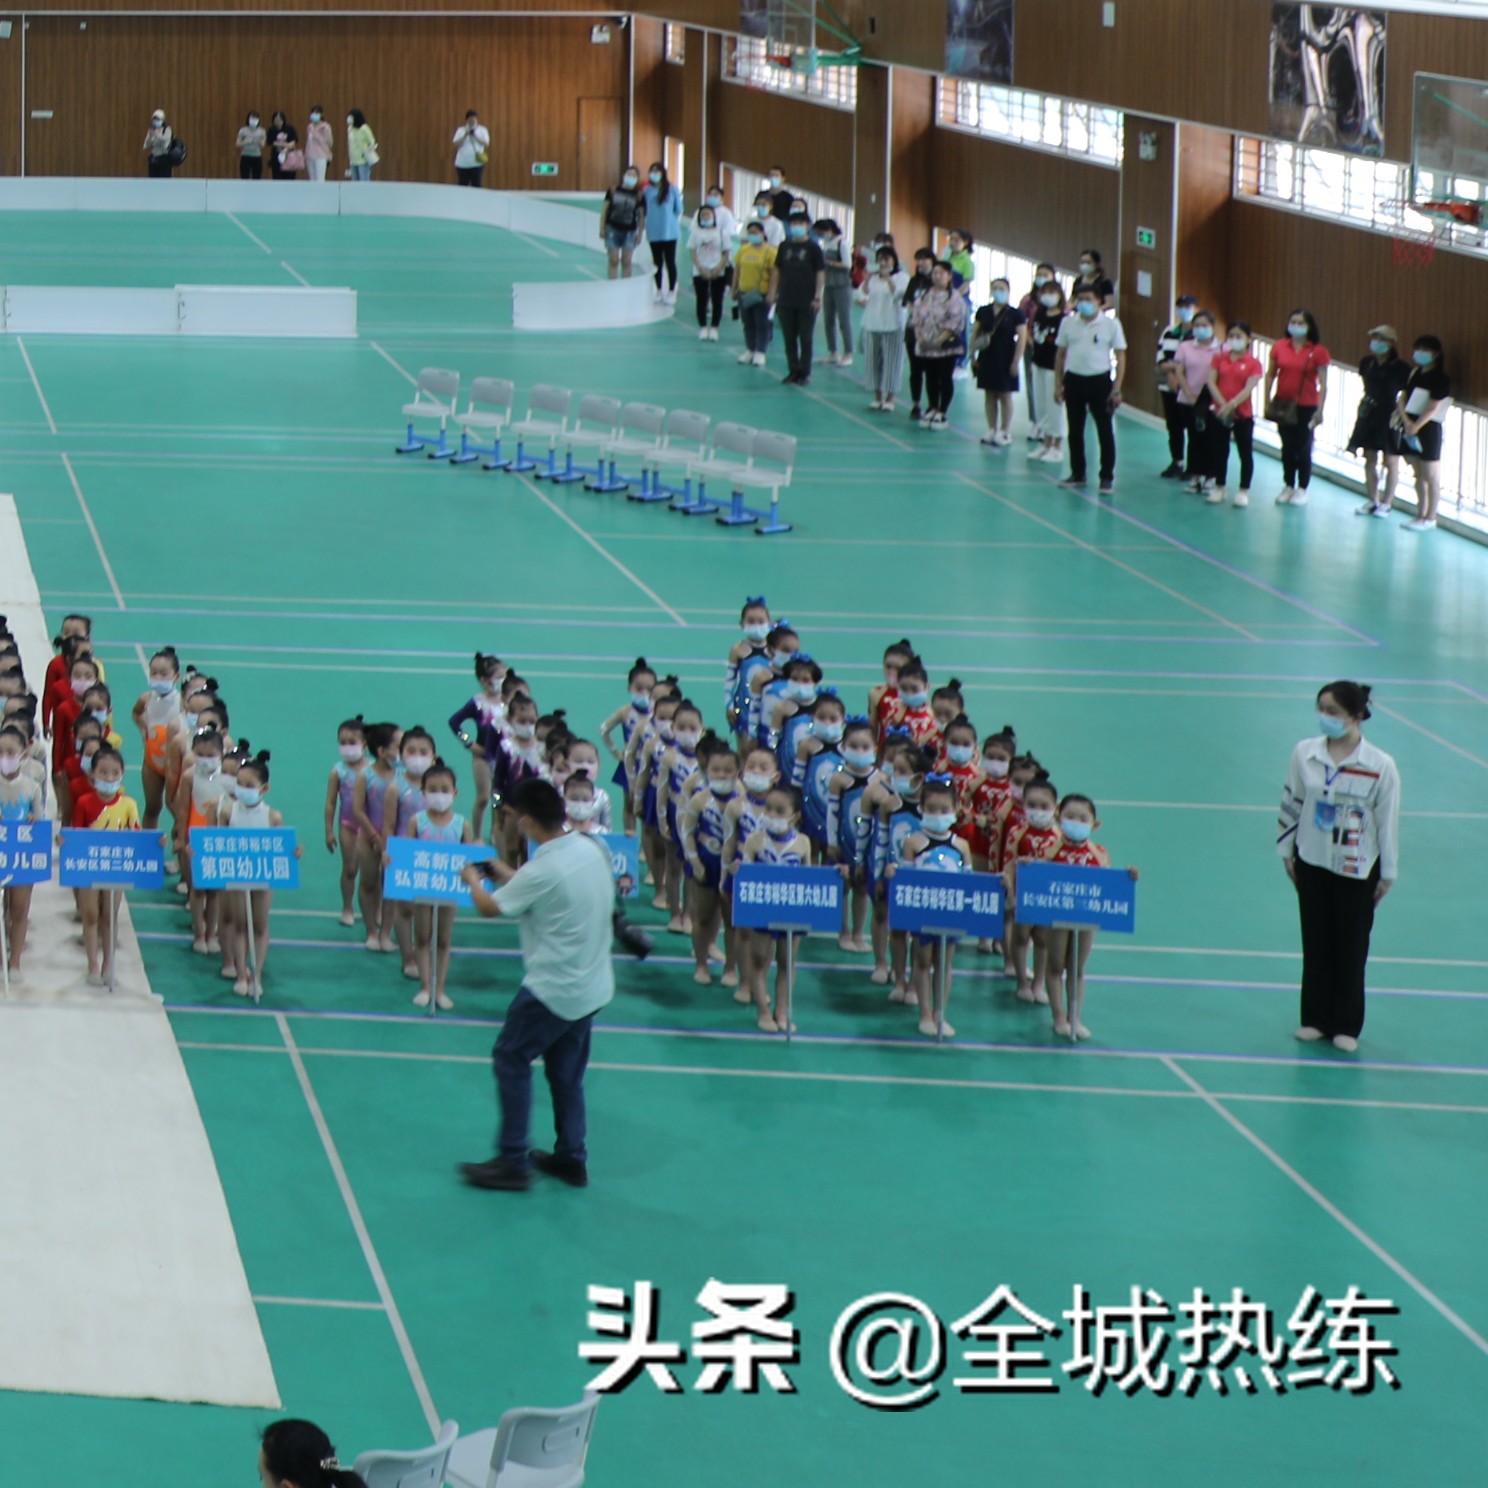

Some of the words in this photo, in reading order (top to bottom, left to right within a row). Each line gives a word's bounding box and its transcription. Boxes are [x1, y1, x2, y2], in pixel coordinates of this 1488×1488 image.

[88, 845, 135, 858] 石家庄市
[203, 836, 285, 853] 石家庄市裕华区
[65, 859, 158, 873] 长安区第二幼儿园
[201, 856, 291, 880] 第四幼儿园
[413, 850, 467, 869] 高新区
[739, 881, 838, 909] 石家庄市裕华区第六幼儿园
[1048, 880, 1102, 896] 石家庄市
[895, 885, 999, 916] 石家庄市裕华区第一幼儿园
